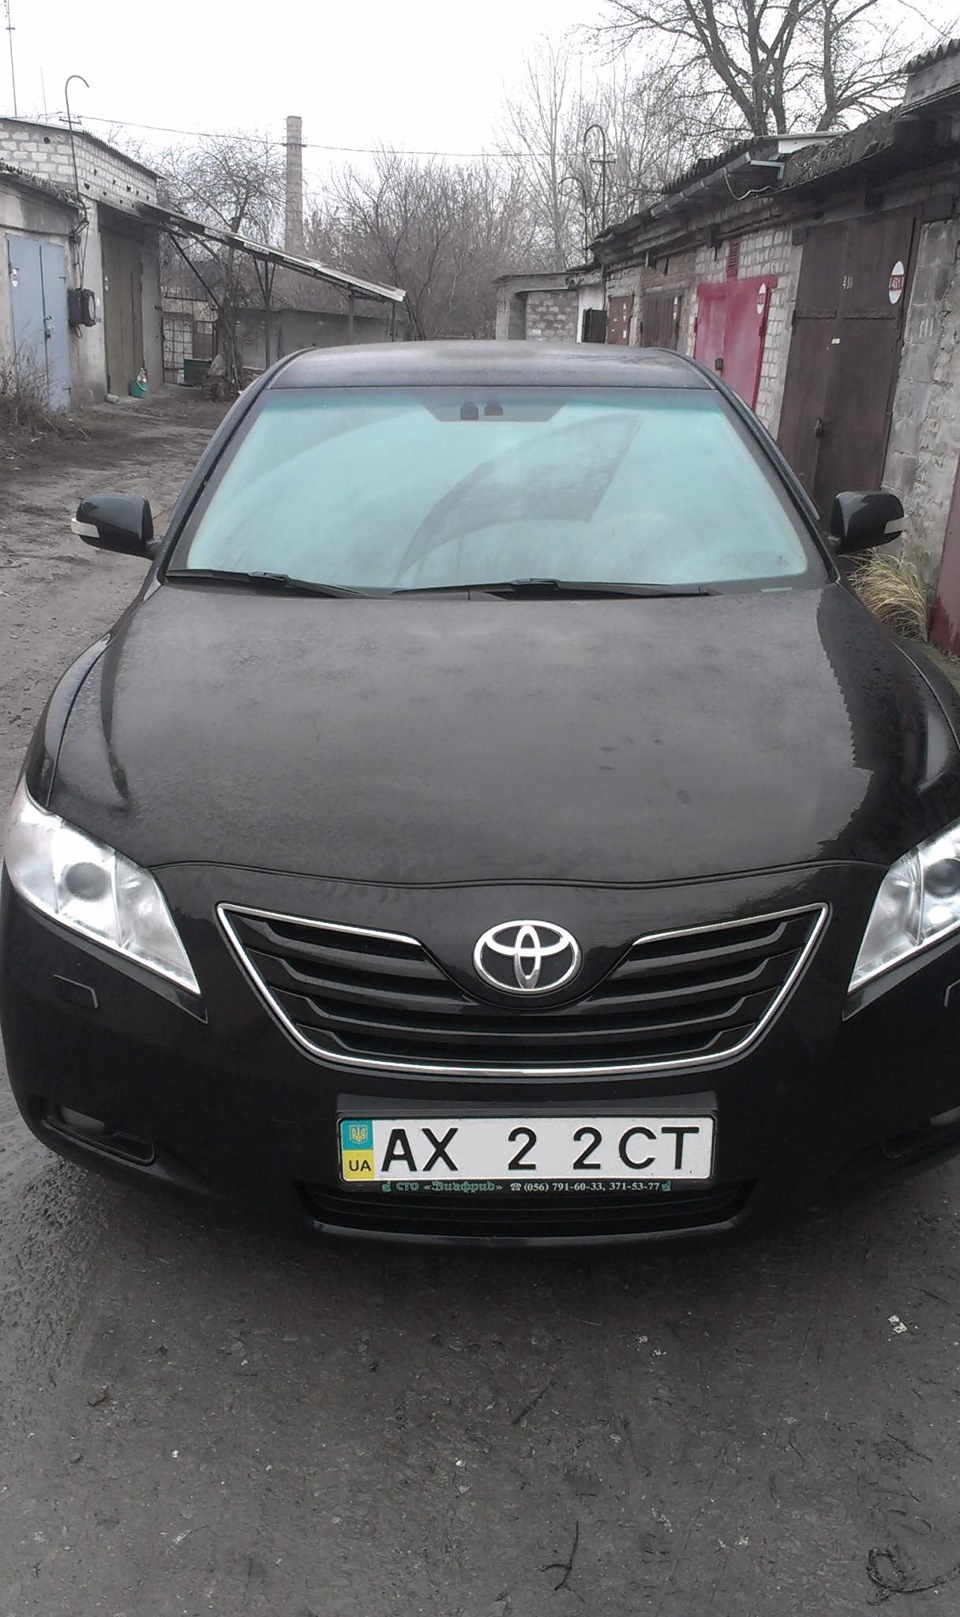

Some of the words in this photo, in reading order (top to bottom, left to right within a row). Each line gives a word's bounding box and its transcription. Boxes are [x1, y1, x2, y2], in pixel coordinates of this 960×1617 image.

[381, 1128, 459, 1172] AX
[348, 1160, 372, 1172] UA
[523, 1182, 550, 1193] (056)
[552, 1182, 606, 1192] 791-60-33,
[609, 1181, 660, 1191] 371-53-77
